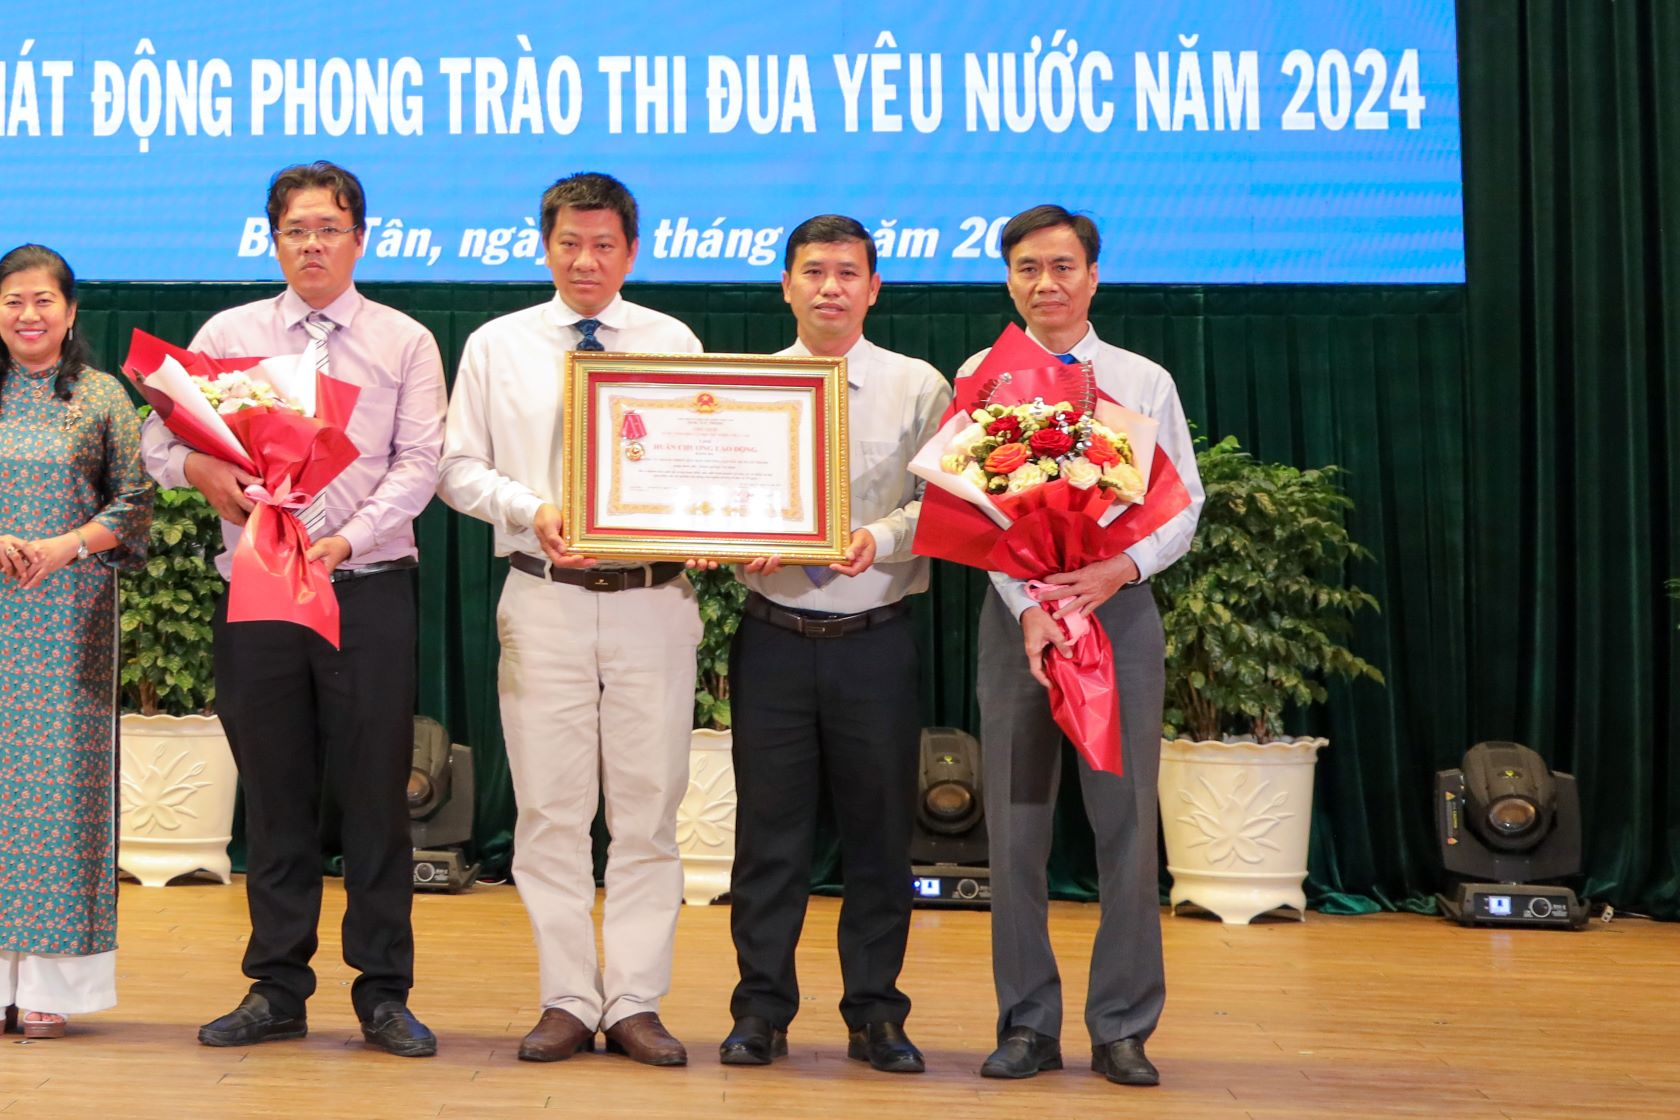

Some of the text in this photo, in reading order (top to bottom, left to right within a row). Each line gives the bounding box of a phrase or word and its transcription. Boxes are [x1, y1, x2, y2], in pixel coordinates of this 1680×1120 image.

[90, 37, 233, 154] ĐỘNG
[250, 56, 424, 138] PHONG
[439, 33, 583, 136] TRÀO
[598, 55, 687, 135] THI
[704, 54, 817, 135] ĐUA
[833, 29, 943, 134] YÊU
[965, 28, 1114, 134] NƯỚC
[1135, 33, 1260, 132] NĂM
[1281, 48, 1426, 132] 2024
[458, 216, 547, 266] ngà
[653, 216, 785, 266] tháng
[864, 218, 940, 259] ăm
